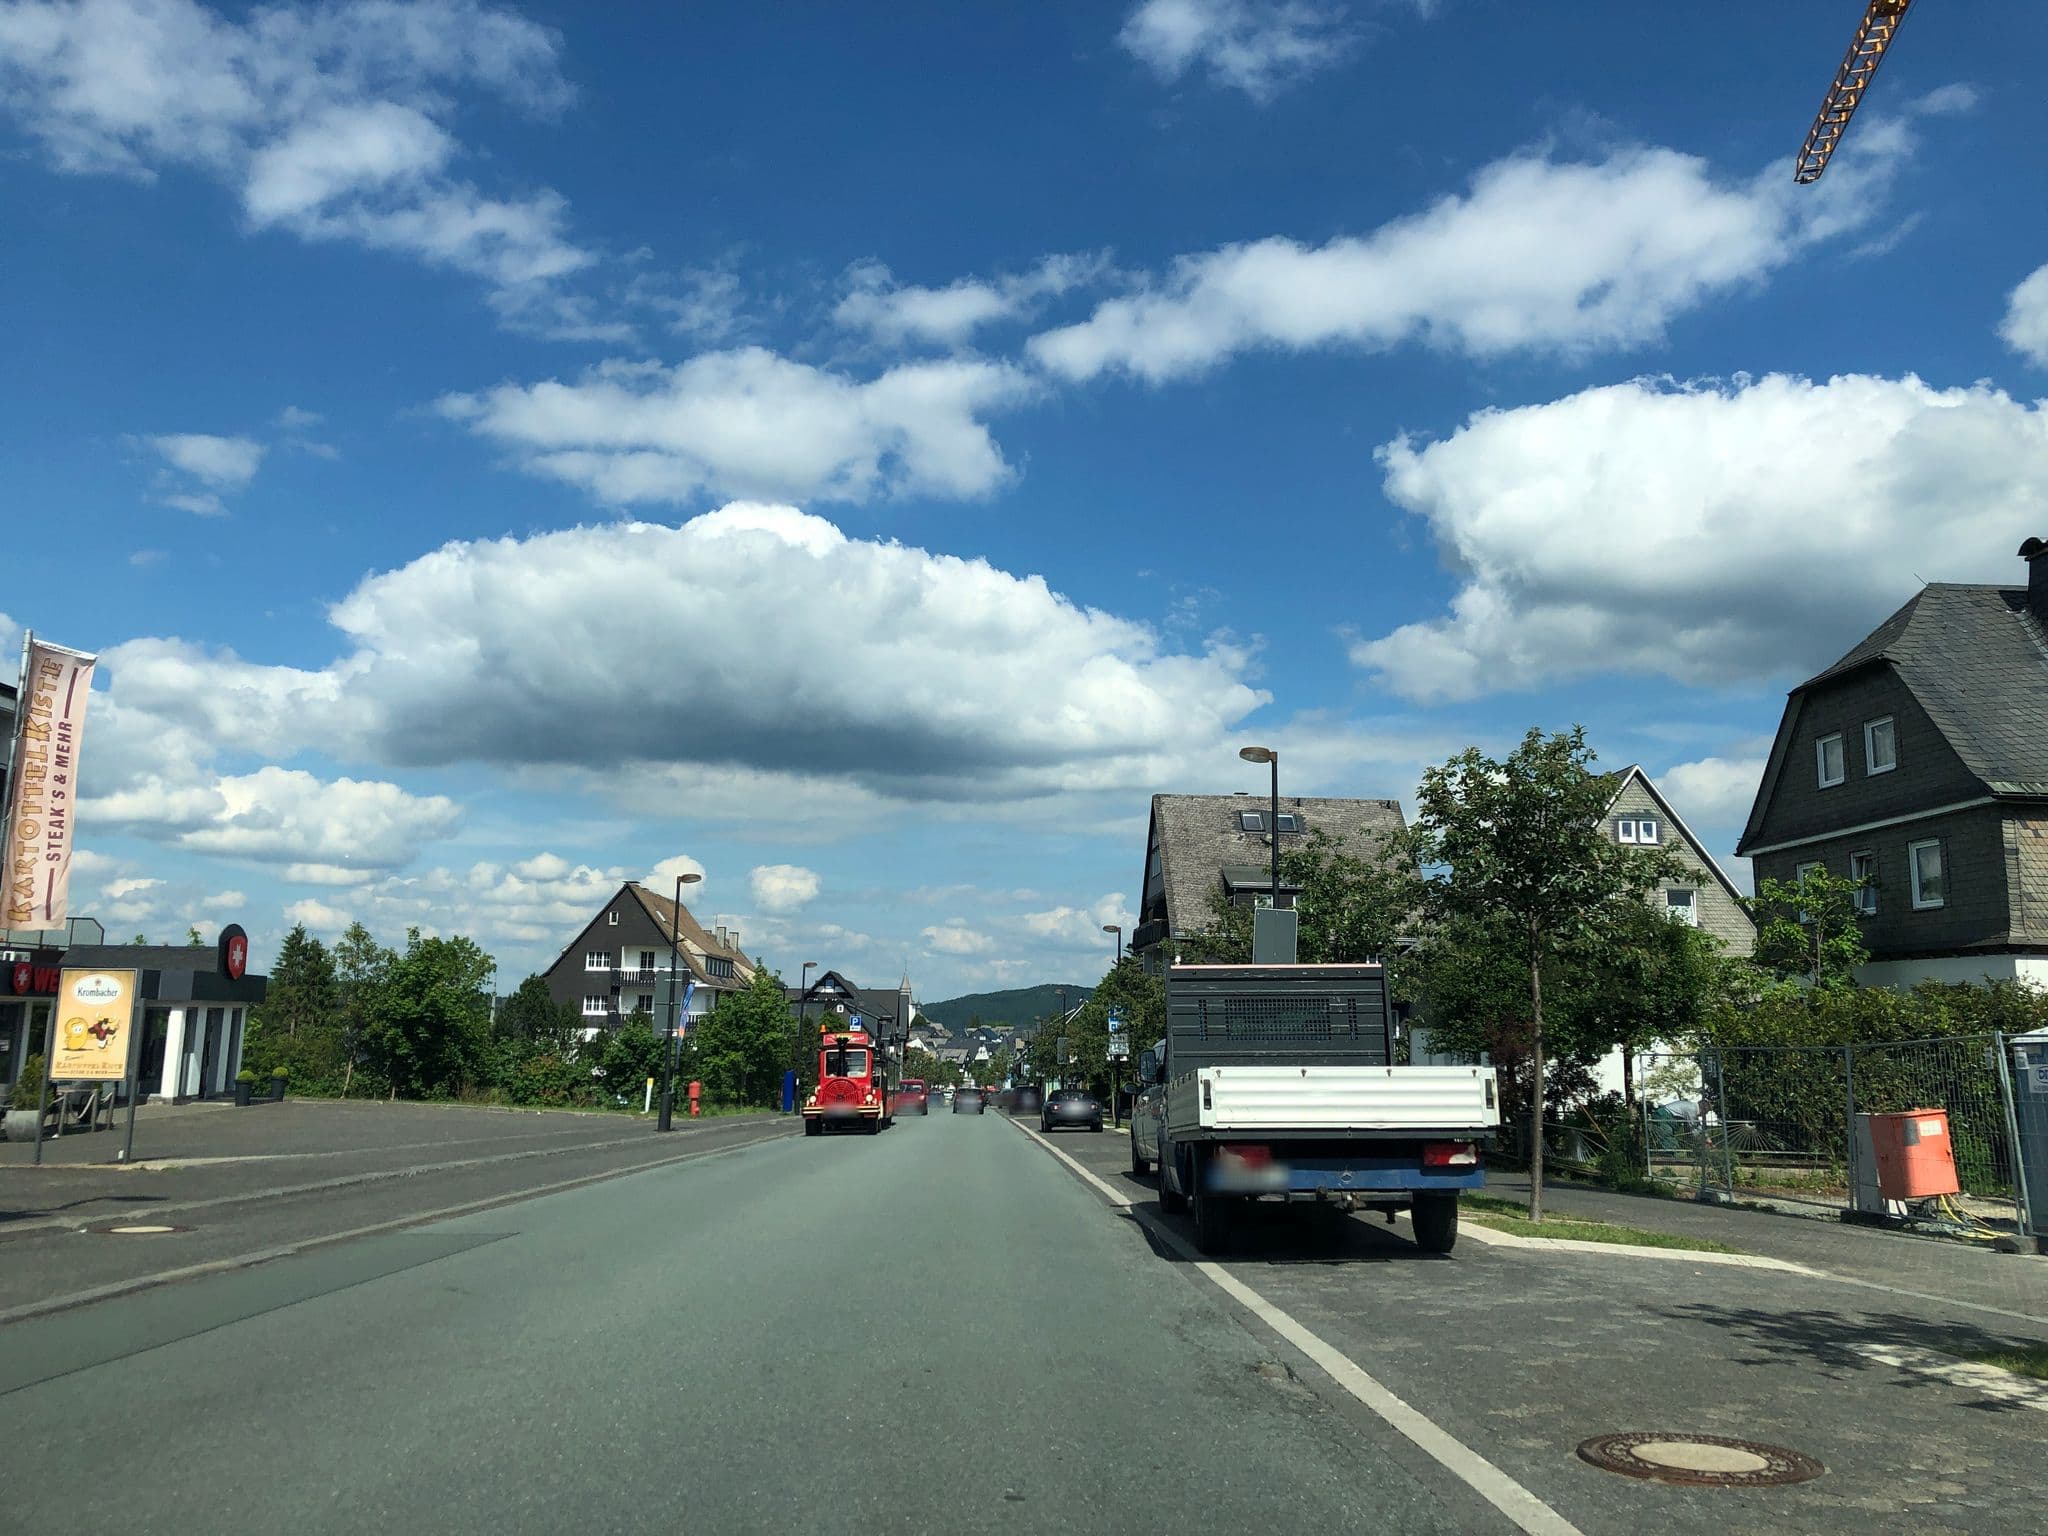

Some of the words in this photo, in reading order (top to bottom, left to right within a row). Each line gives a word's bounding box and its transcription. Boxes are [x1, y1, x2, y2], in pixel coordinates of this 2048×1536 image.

[55, 721, 72, 768] MEHR
[54, 774, 66, 785] &
[77, 986, 119, 997] Krombacher
